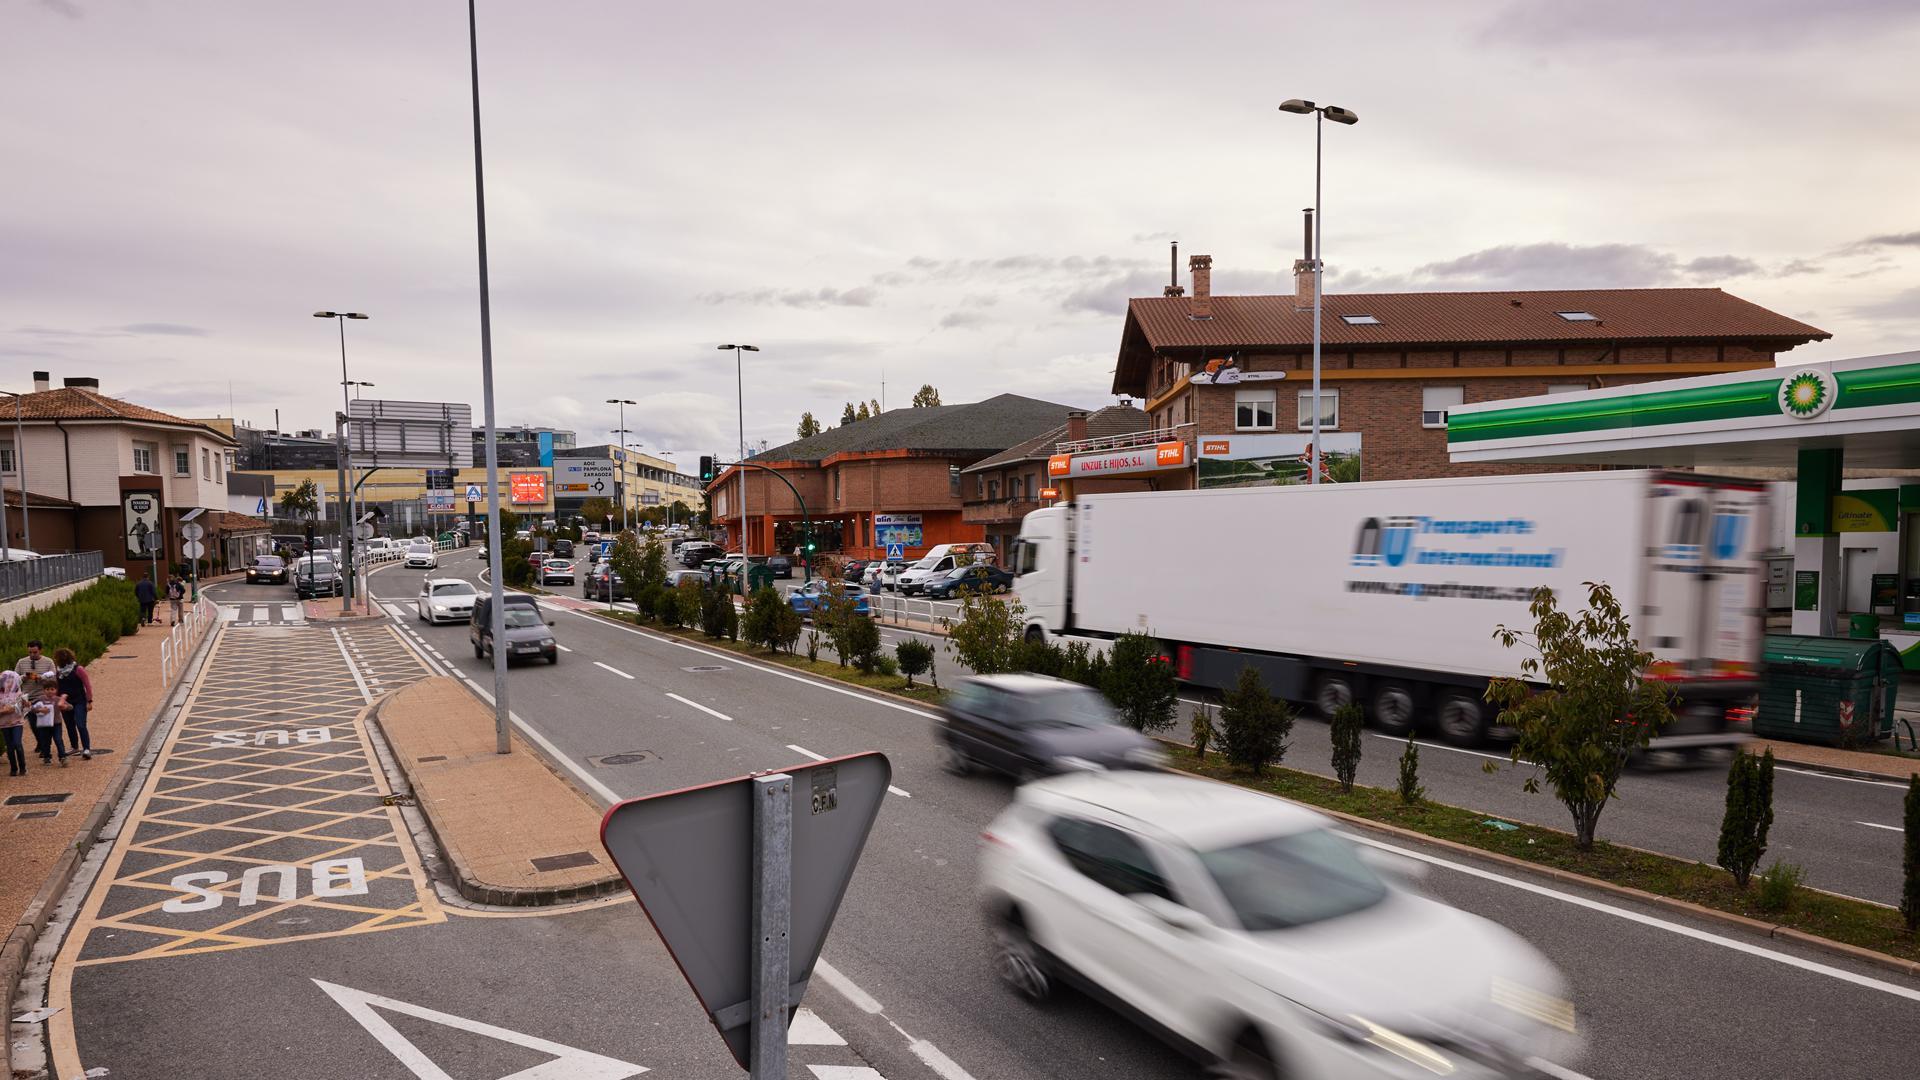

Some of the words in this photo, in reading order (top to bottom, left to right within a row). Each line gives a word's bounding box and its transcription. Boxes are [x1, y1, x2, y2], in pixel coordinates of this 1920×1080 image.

[1158, 448, 1180, 459] STIHL
[1050, 460, 1067, 470] STIHL
[1081, 460, 1102, 472] UNZUE
[1104, 459, 1108, 469] E
[1109, 457, 1131, 471] HIJOS,
[1132, 456, 1145, 467] S.L.
[210, 727, 332, 747] BUS
[161, 857, 369, 913] BUS
